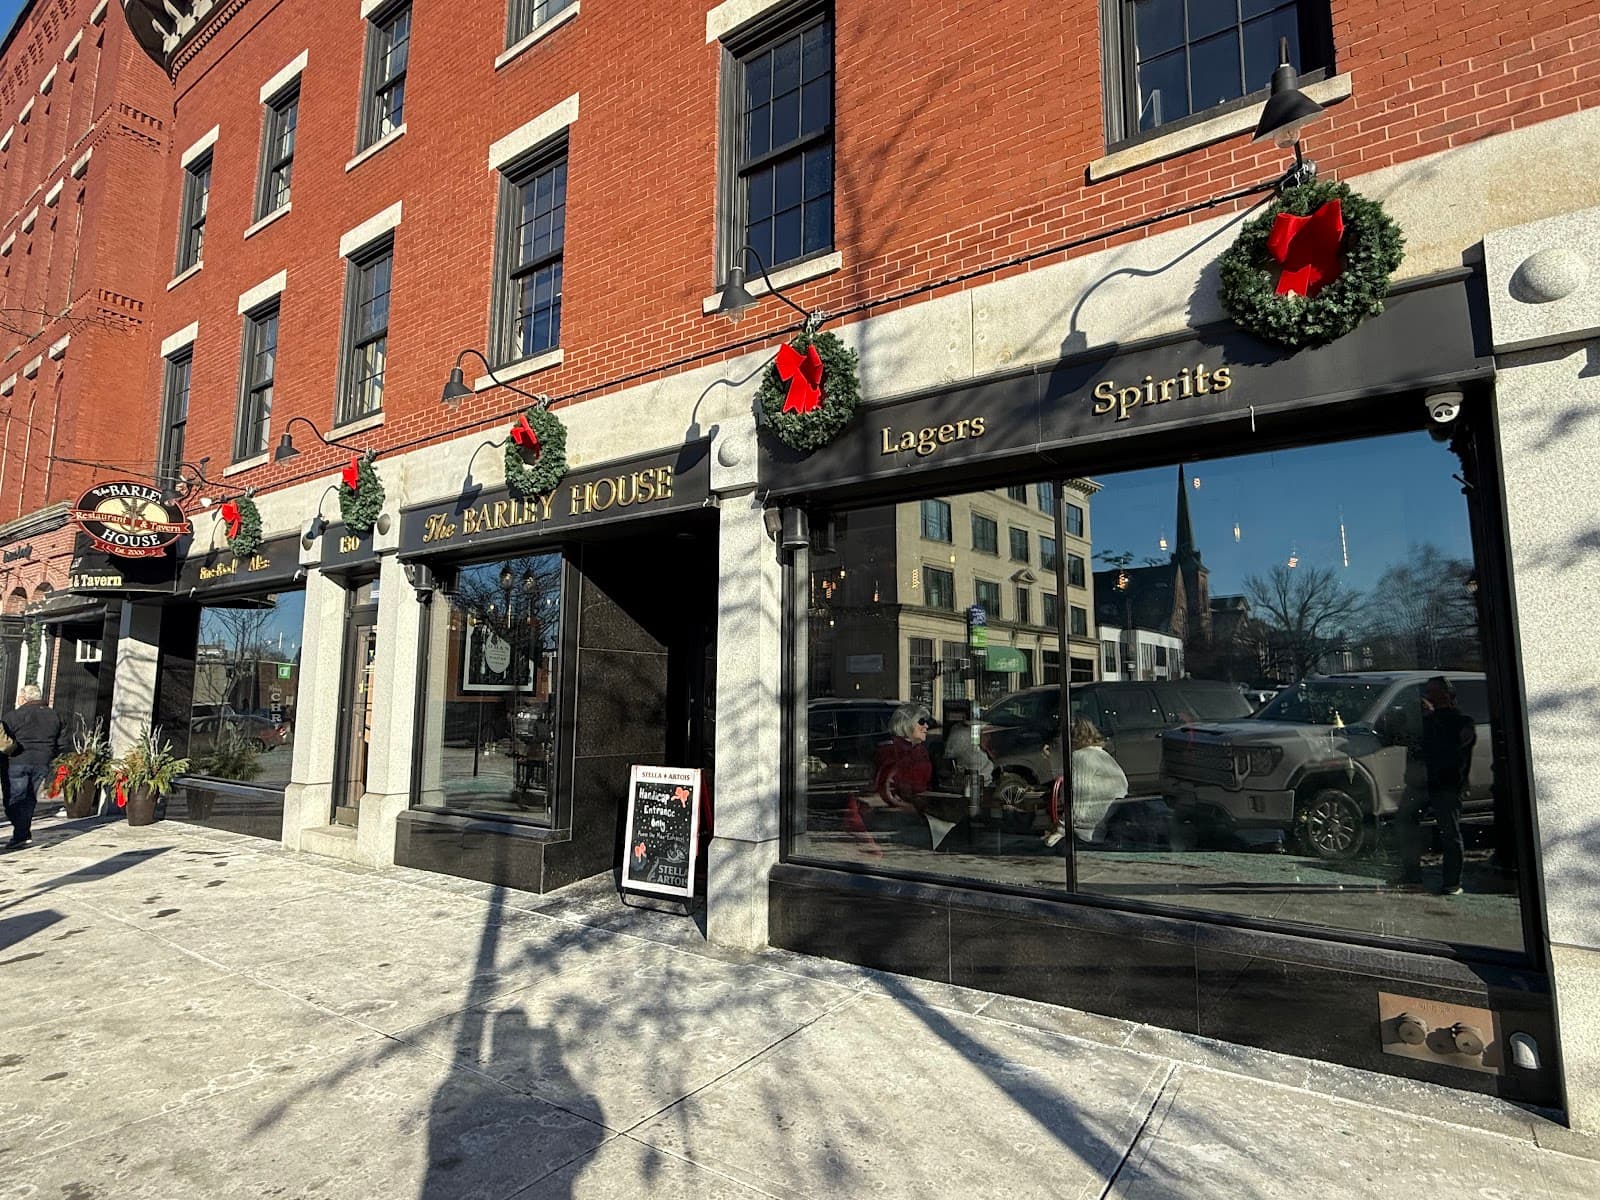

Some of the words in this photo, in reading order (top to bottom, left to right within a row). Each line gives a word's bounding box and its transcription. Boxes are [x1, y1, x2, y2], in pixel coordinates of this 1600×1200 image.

[1091, 363, 1233, 422] Spirits
[880, 415, 986, 456] Lagers
[421, 513, 456, 543] The
[461, 489, 557, 536] BARLEY
[568, 465, 674, 516] HOUSE
[75, 511, 128, 525] Restaurant
[151, 522, 181, 532] Tavern
[101, 529, 161, 547] HOUSE
[338, 535, 360, 554] 130
[81, 575, 122, 588] Tavern
[642, 771, 662, 779] STELLA
[668, 773, 690, 781] ARTOIS
[639, 787, 670, 805] Handicap
[643, 804, 676, 818] Entrance
[651, 817, 666, 832] Only
